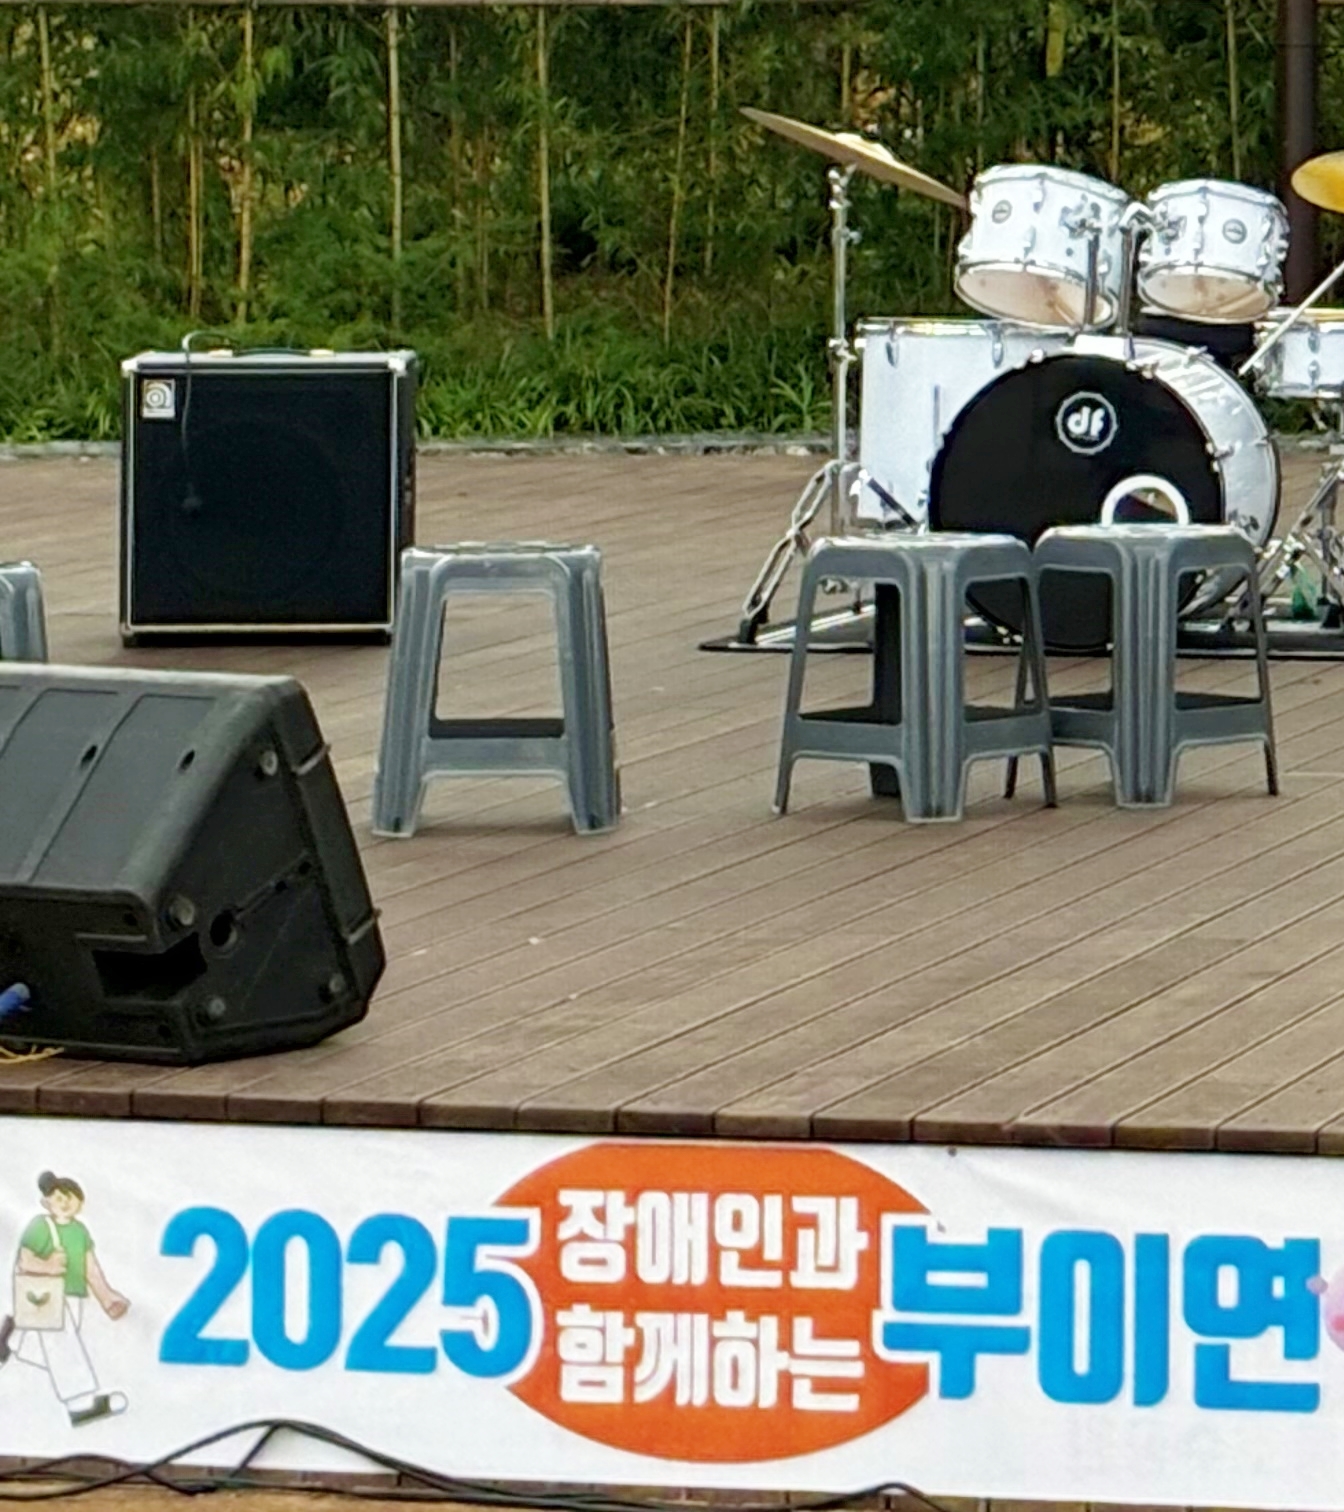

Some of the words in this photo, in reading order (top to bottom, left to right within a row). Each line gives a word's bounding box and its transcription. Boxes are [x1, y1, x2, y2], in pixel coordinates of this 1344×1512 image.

[159, 1205, 534, 1378] 2025
[557, 1189, 868, 1290] 장애인과
[556, 1305, 866, 1411] 함께하는
[882, 1224, 1320, 1413] 부이연
